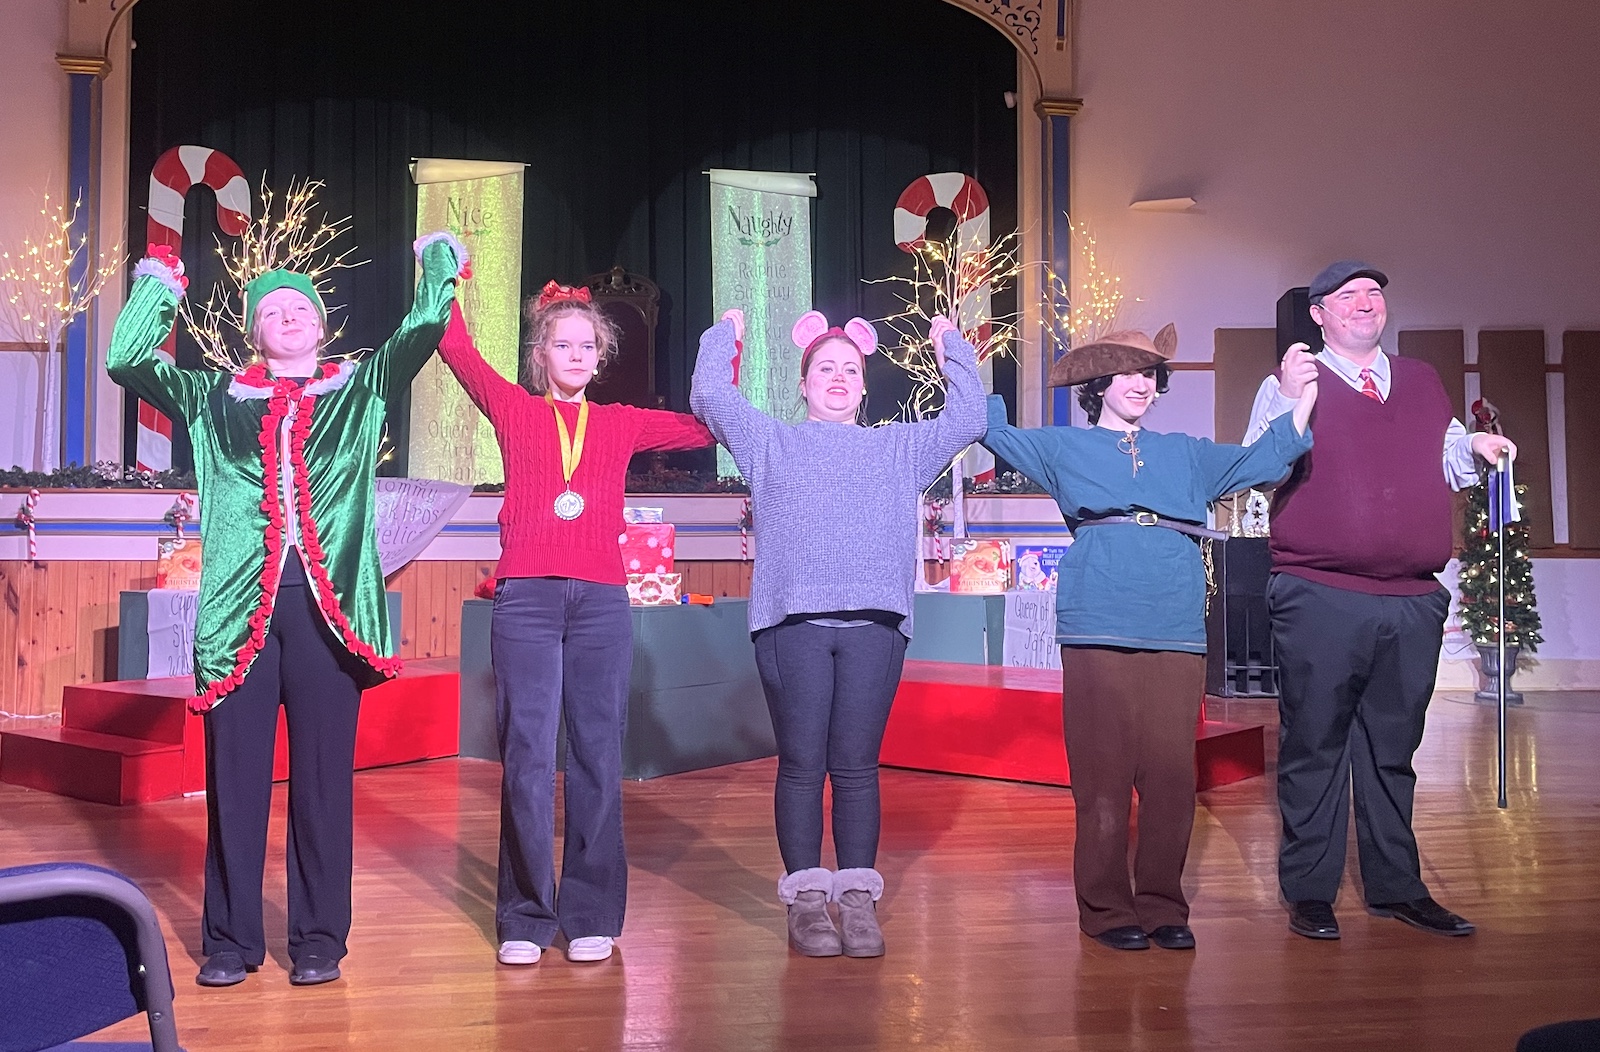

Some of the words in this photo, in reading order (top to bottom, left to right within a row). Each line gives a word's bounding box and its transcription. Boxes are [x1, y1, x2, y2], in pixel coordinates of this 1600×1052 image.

[446, 197, 492, 228] Nice
[728, 205, 793, 238] Naughty
[734, 284, 756, 300] Sir
[761, 284, 790, 300] Guy
[428, 420, 468, 439] Other
[1015, 595, 1038, 622] Queen
